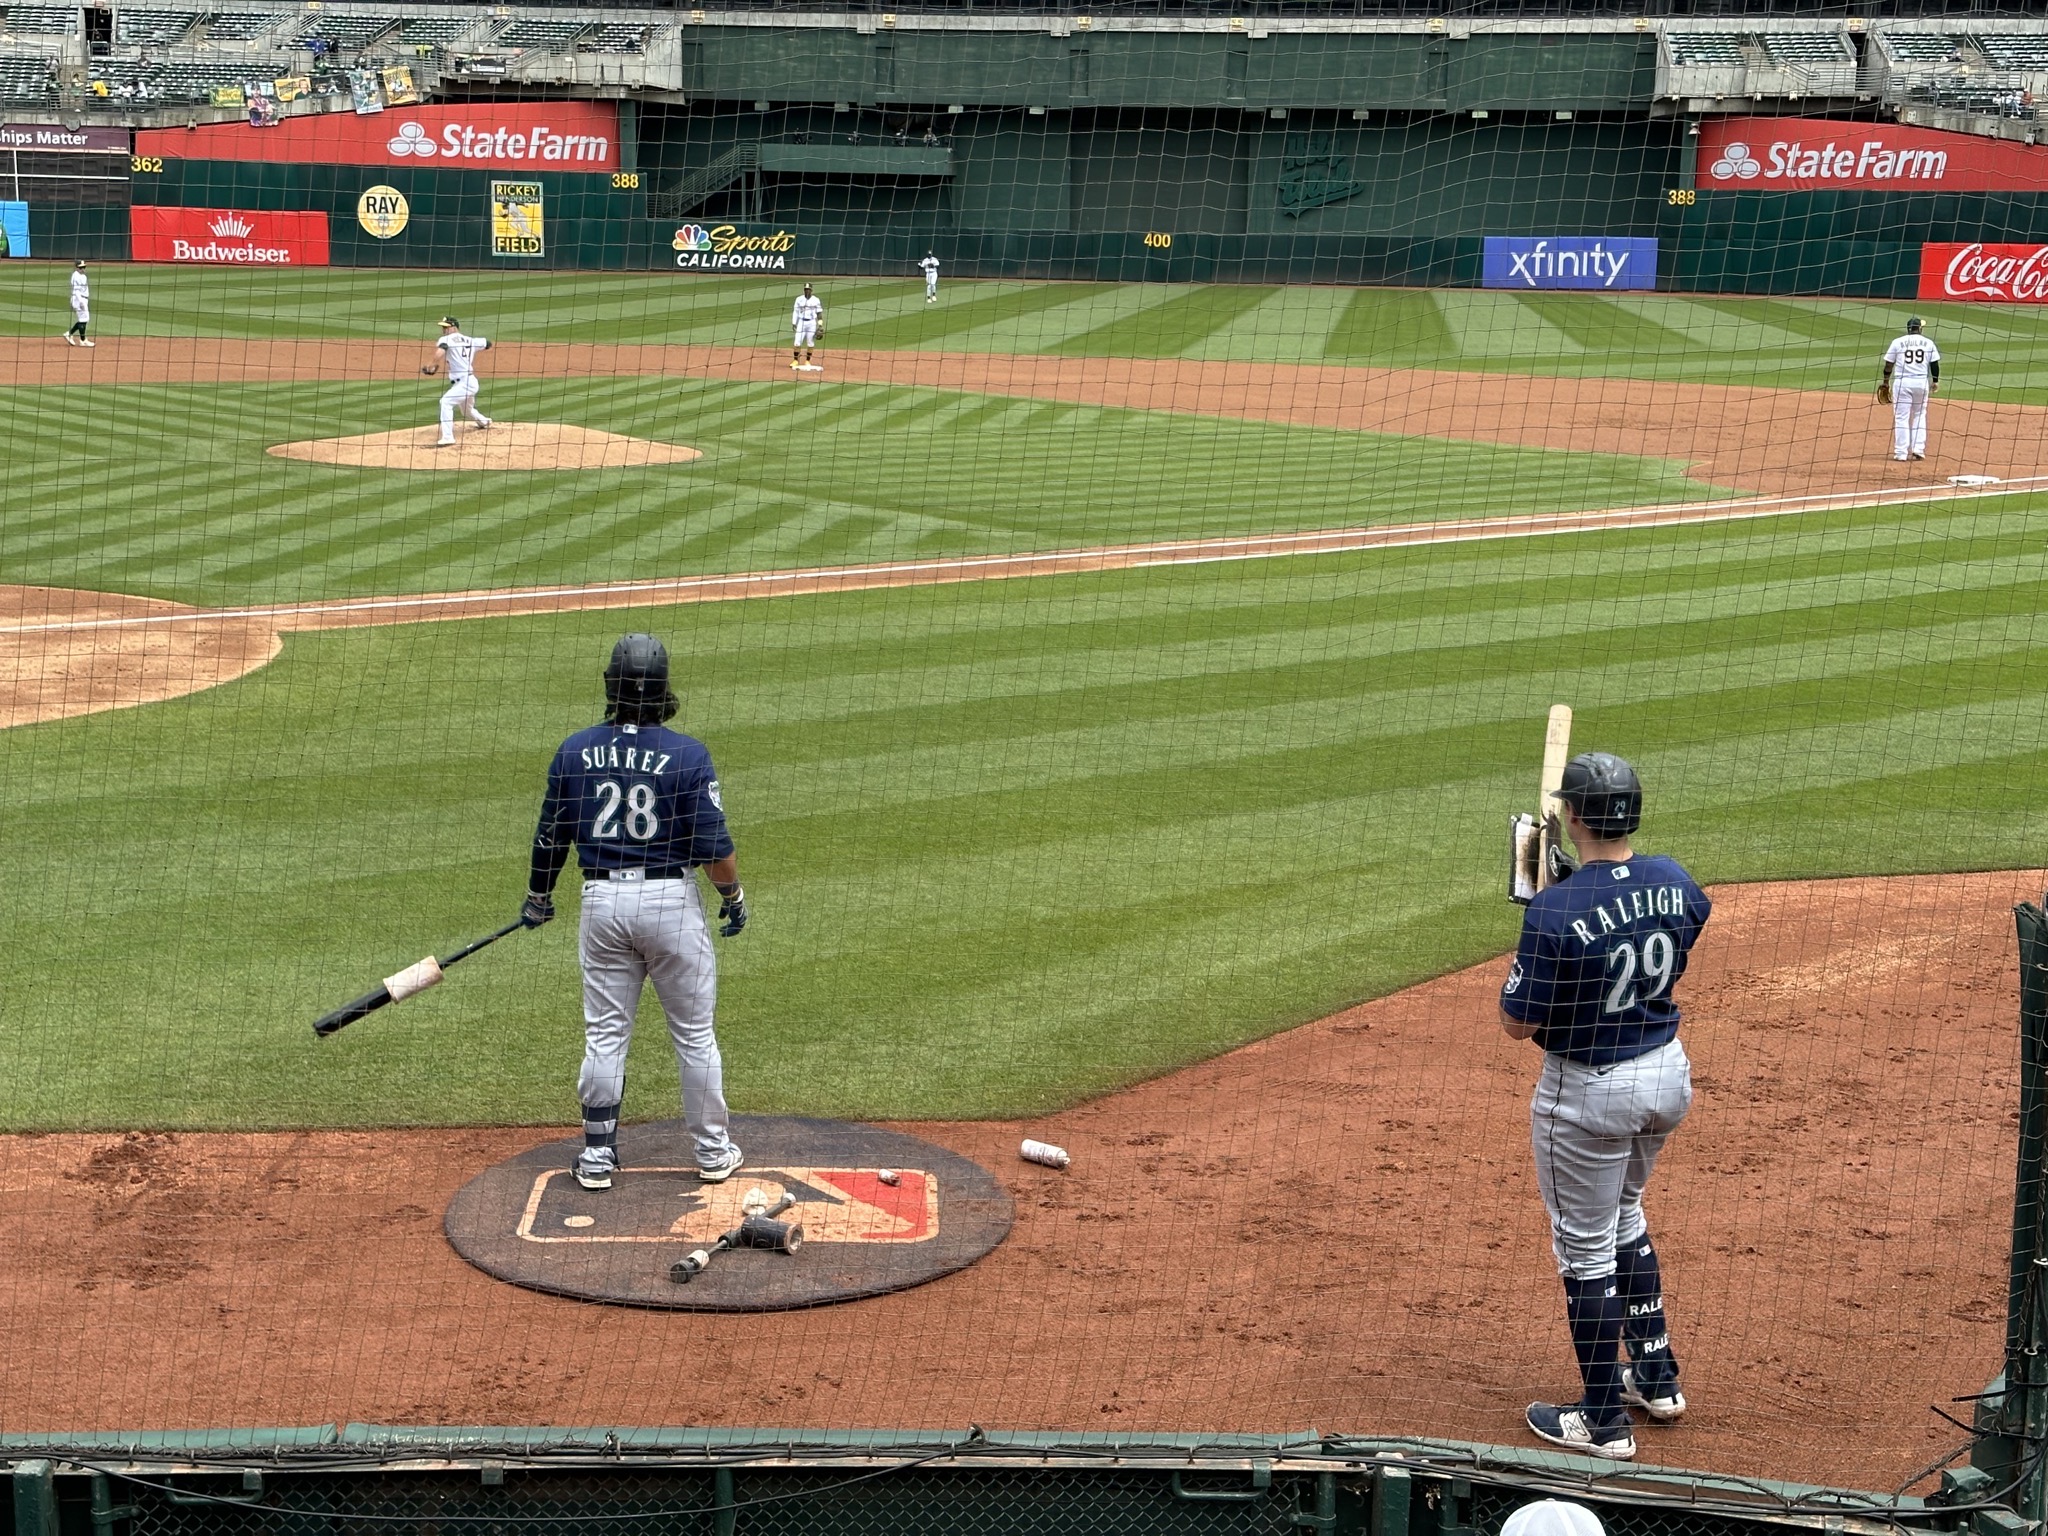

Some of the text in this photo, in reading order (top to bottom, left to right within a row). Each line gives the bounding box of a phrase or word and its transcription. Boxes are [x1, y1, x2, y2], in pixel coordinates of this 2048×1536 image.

[0, 129, 88, 146] hips Matter
[130, 157, 163, 173] 362
[611, 173, 639, 189] 388
[496, 185, 538, 196] RICKEY
[1668, 190, 1696, 206] 388
[366, 196, 399, 214] RAY
[497, 237, 539, 253] FIELD
[709, 224, 796, 257] Sports
[1143, 232, 1171, 248] 400
[676, 252, 785, 269] CALIFORNIA
[1508, 241, 1630, 287] xfinity
[1904, 349, 1924, 364] 99
[581, 737, 671, 775] SUÁREZ
[592, 780, 659, 840] 28
[1614, 800, 1626, 811] 29
[1571, 886, 1685, 945] RALEIGH
[1603, 930, 1676, 1015] 29
